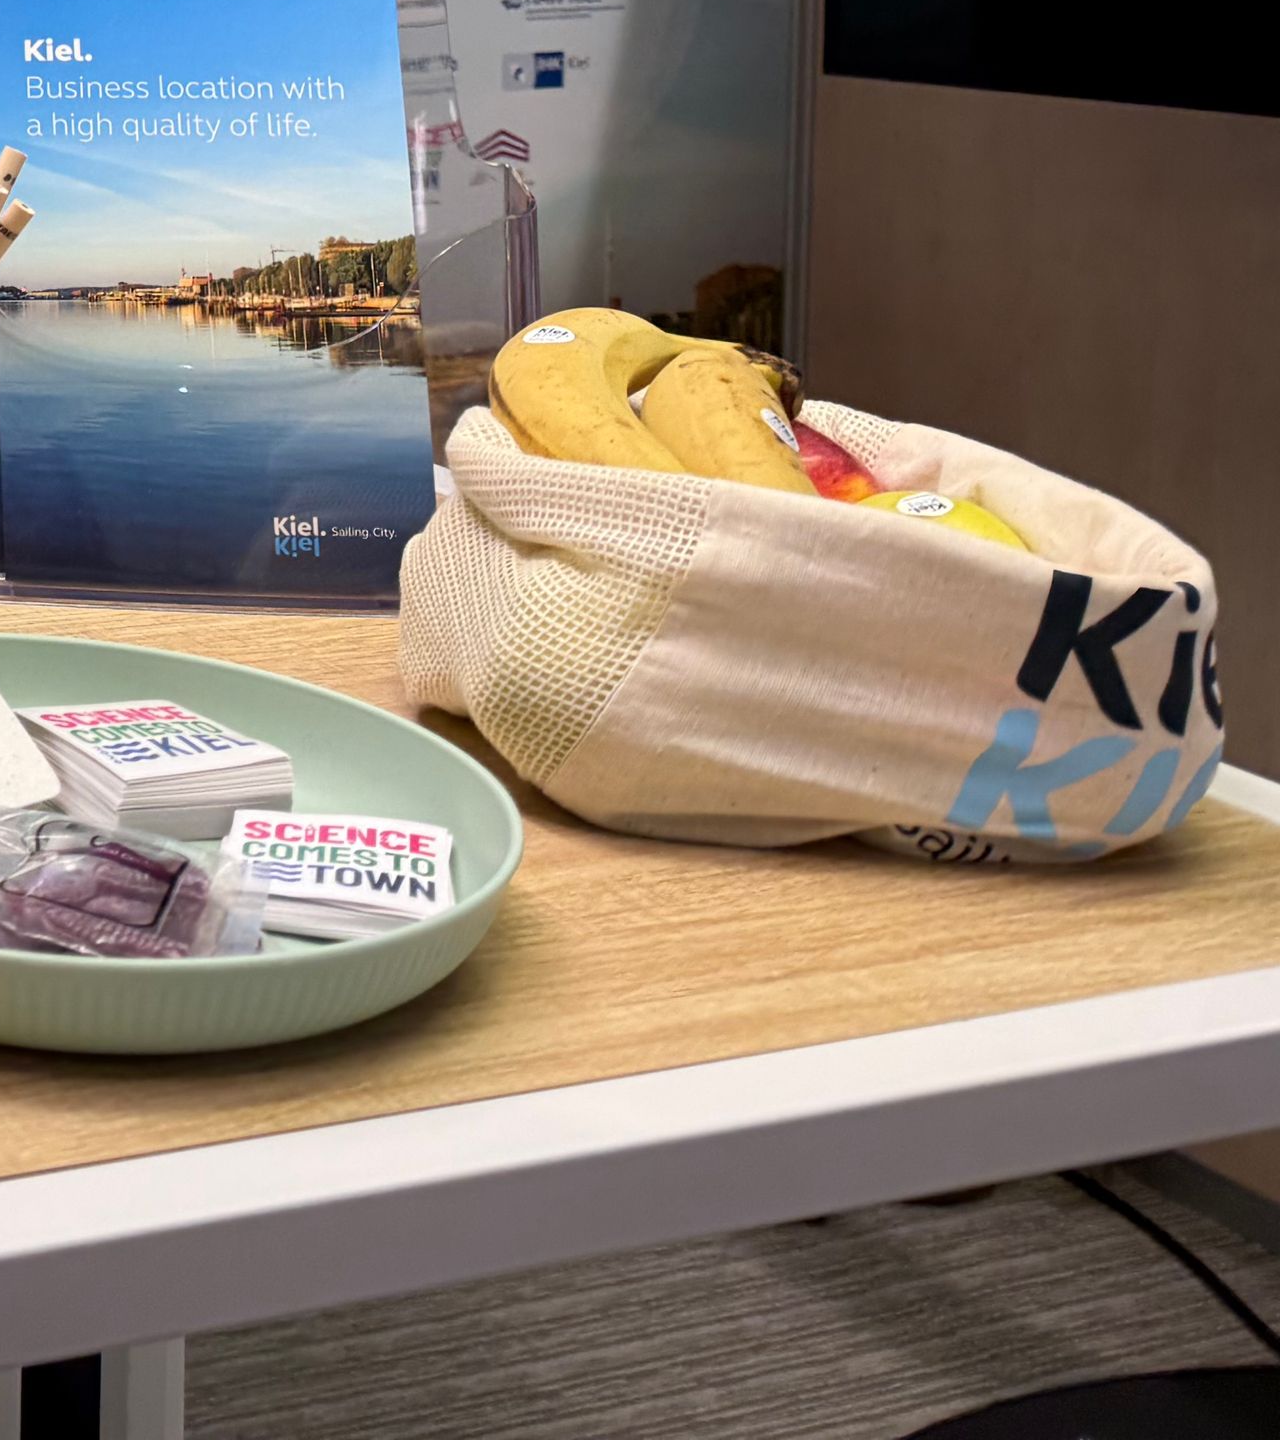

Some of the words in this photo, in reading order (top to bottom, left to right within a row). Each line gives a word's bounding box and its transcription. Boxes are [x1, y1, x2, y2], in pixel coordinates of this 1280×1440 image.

[24, 38, 93, 62] Kiel.
[26, 75, 149, 100] Business
[159, 75, 274, 101] location
[282, 75, 345, 101] with
[26, 118, 43, 137] a
[53, 113, 114, 142] high
[122, 113, 220, 143] quality
[229, 112, 259, 137] of
[266, 112, 318, 138] life.
[273, 515, 326, 537] Kiel.
[40, 706, 198, 729] SCIENCE
[70, 722, 183, 744] COMES
[176, 721, 223, 734] TO
[147, 733, 258, 758] KIEL
[244, 821, 437, 858] SCIENCE
[242, 841, 378, 867] COMES
[384, 852, 436, 877] TO
[307, 864, 436, 902] TOWN
